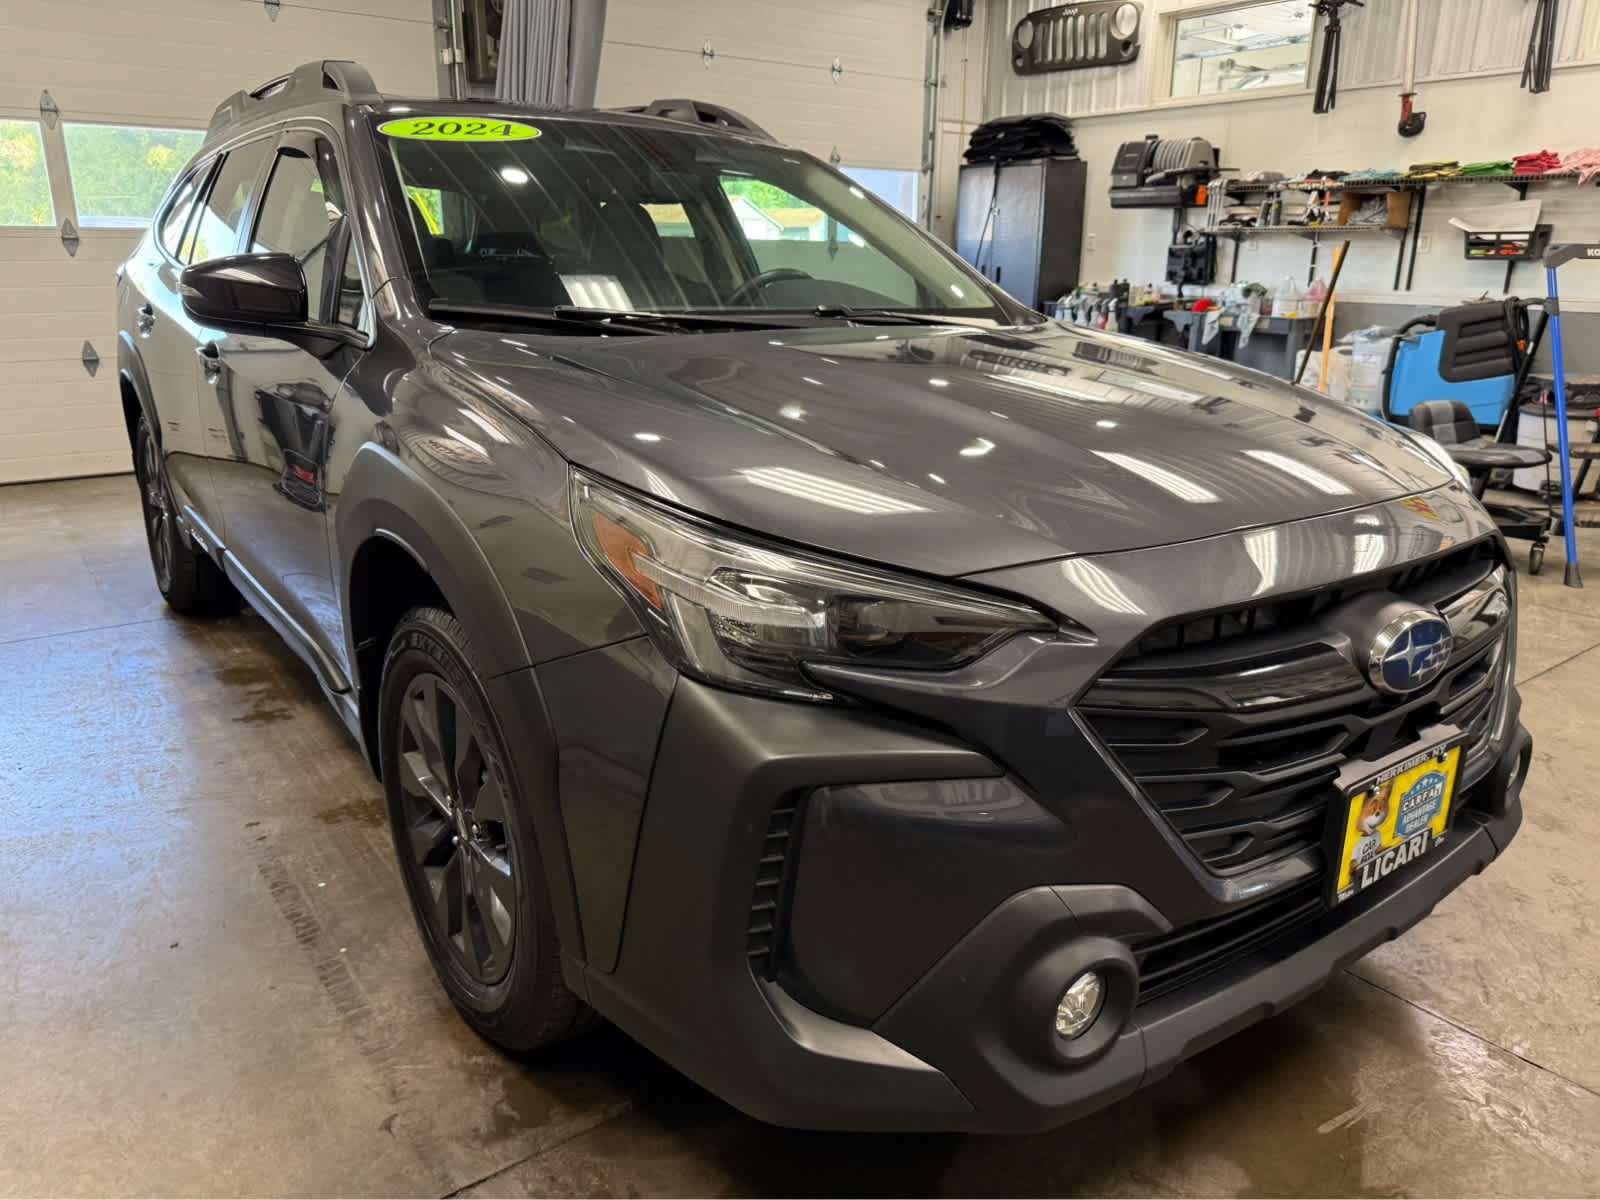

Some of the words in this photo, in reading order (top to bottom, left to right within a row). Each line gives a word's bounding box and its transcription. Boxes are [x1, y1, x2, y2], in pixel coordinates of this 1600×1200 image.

[411, 122, 512, 137] 2024
[1362, 838, 1377, 856] CAR
[1360, 830, 1429, 889] LICARI
